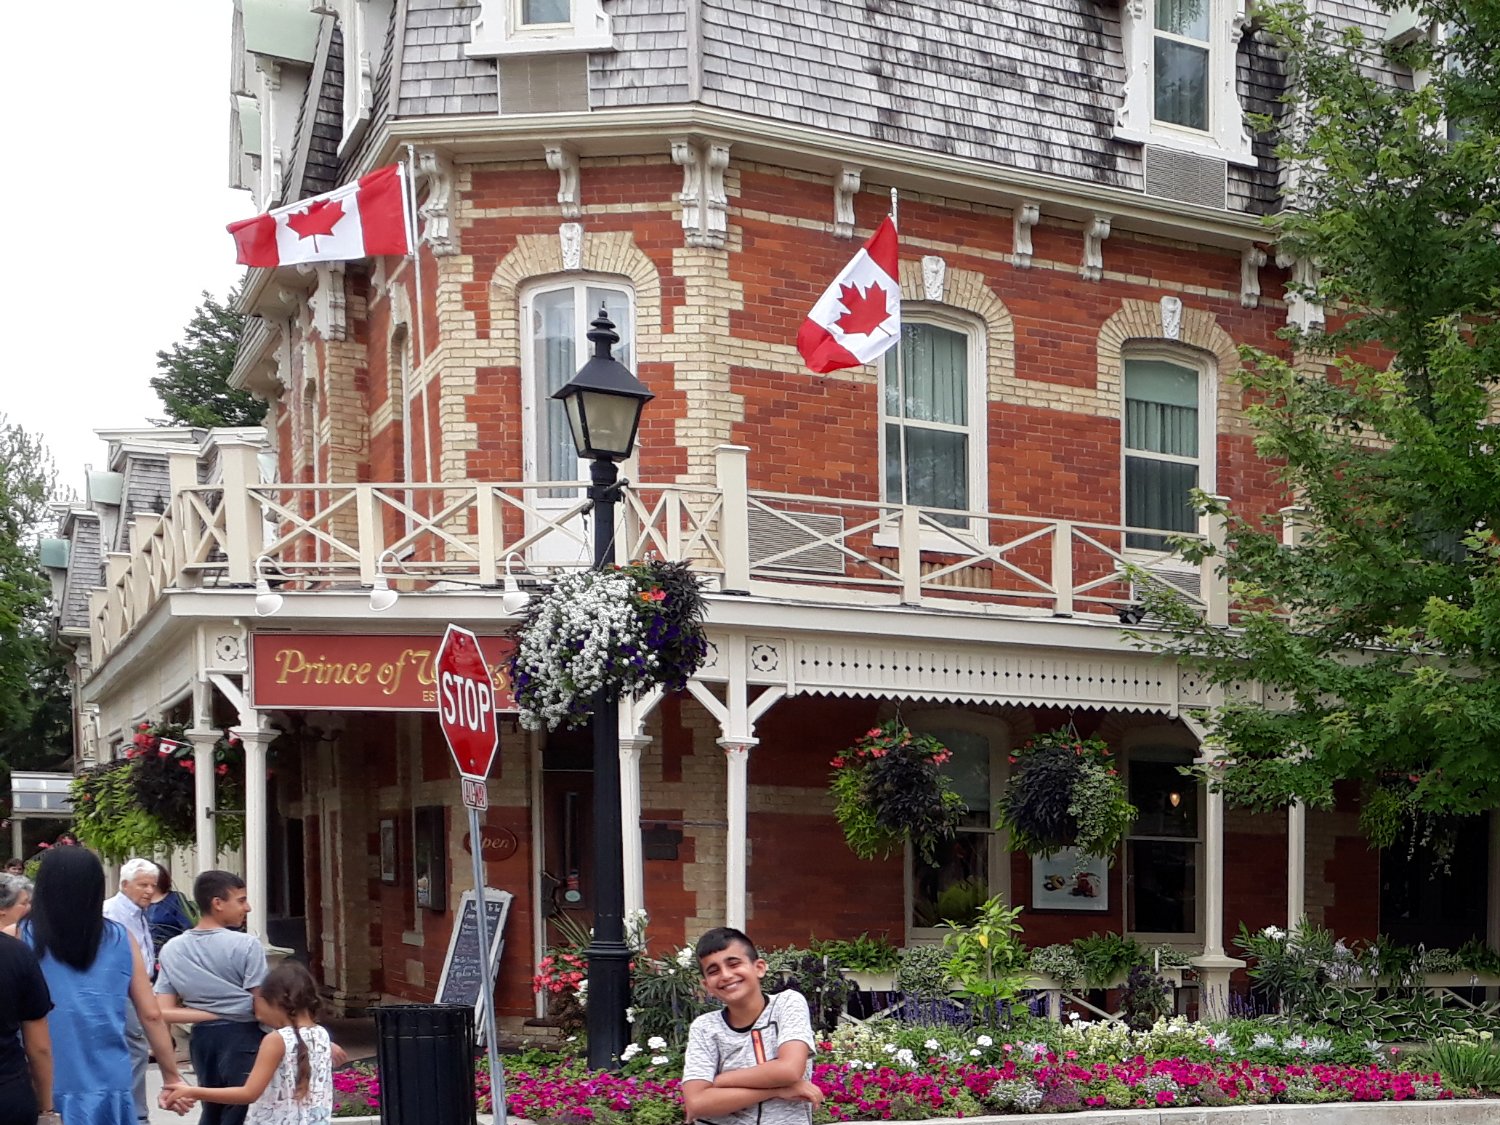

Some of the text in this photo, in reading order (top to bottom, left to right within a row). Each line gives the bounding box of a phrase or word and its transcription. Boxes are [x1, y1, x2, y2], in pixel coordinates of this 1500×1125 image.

[275, 649, 372, 685] Prince
[376, 649, 413, 695] of
[442, 670, 491, 733] STOP
